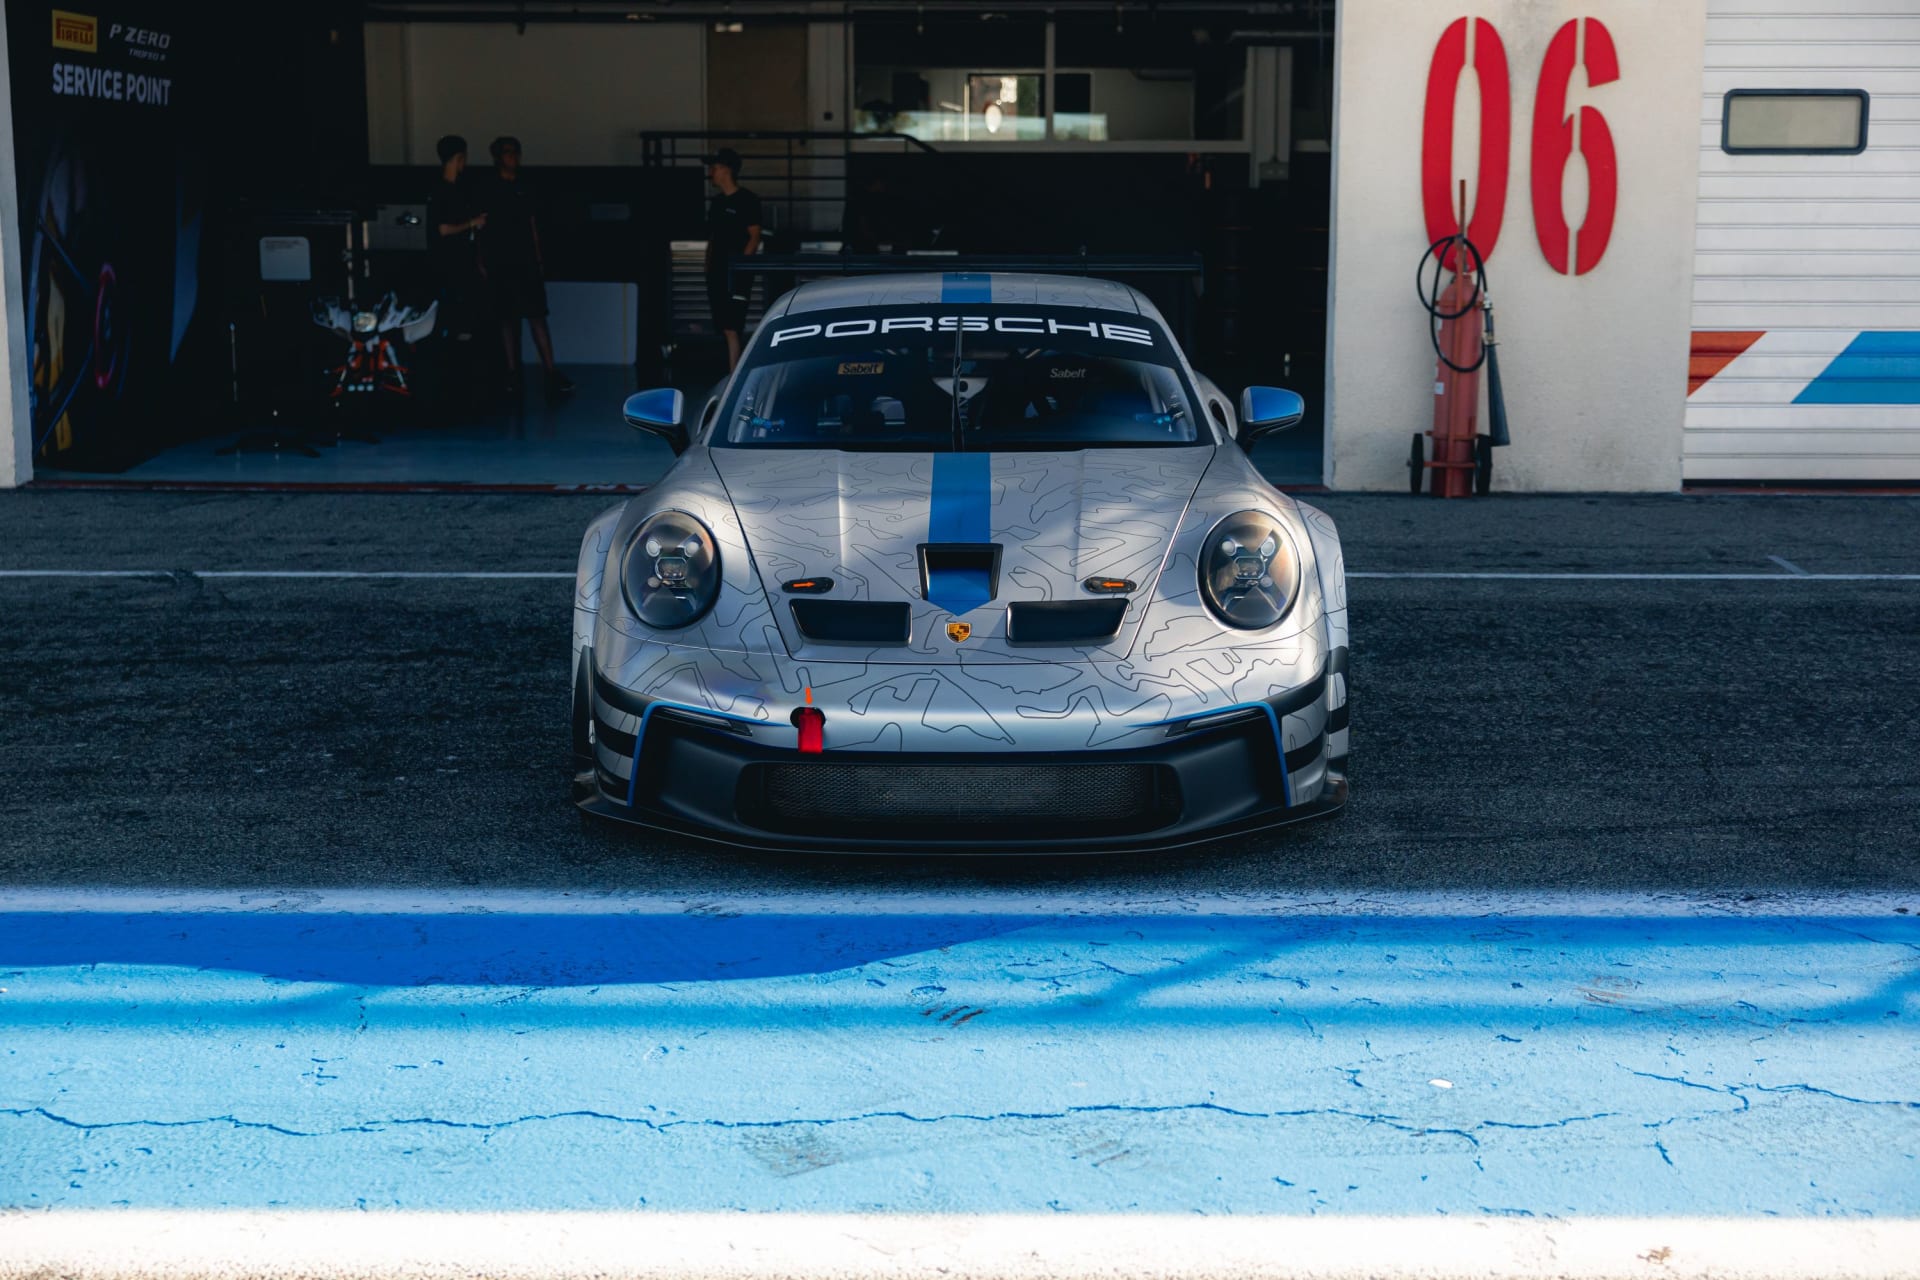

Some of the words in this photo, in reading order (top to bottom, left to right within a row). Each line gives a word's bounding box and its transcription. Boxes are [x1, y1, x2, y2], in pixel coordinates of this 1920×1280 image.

[56, 18, 94, 45] PIRELLI
[109, 23, 122, 39] P
[124, 26, 171, 49] ZERO
[52, 62, 123, 101] SERVICE
[126, 72, 172, 106] POINT
[1421, 16, 1619, 276] 06
[769, 316, 1153, 347] PORSCHE
[842, 362, 880, 374] Sabelt
[1050, 368, 1086, 378] Sabelt
